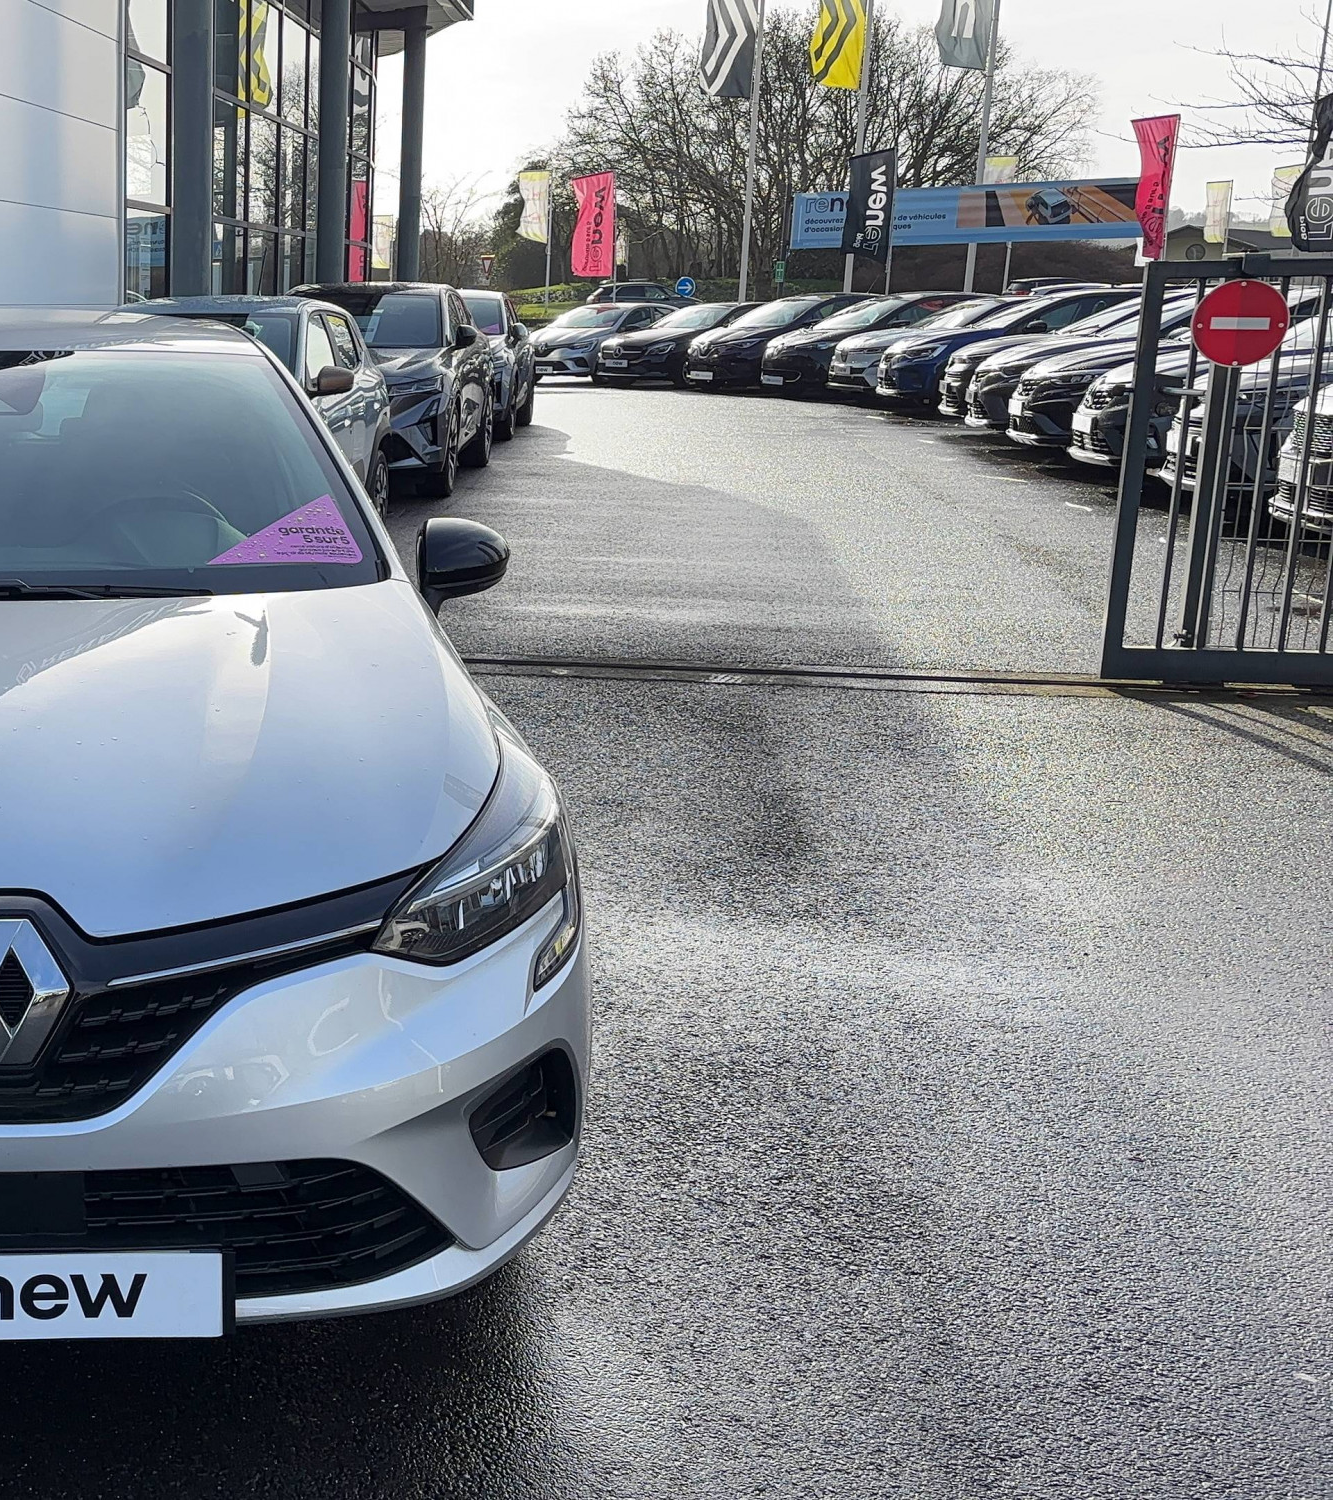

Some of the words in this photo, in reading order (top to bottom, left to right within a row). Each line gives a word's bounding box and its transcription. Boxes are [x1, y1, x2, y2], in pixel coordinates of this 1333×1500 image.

[805, 197, 847, 214] ren
[278, 526, 345, 536] garantie
[314, 536, 338, 544] sur
